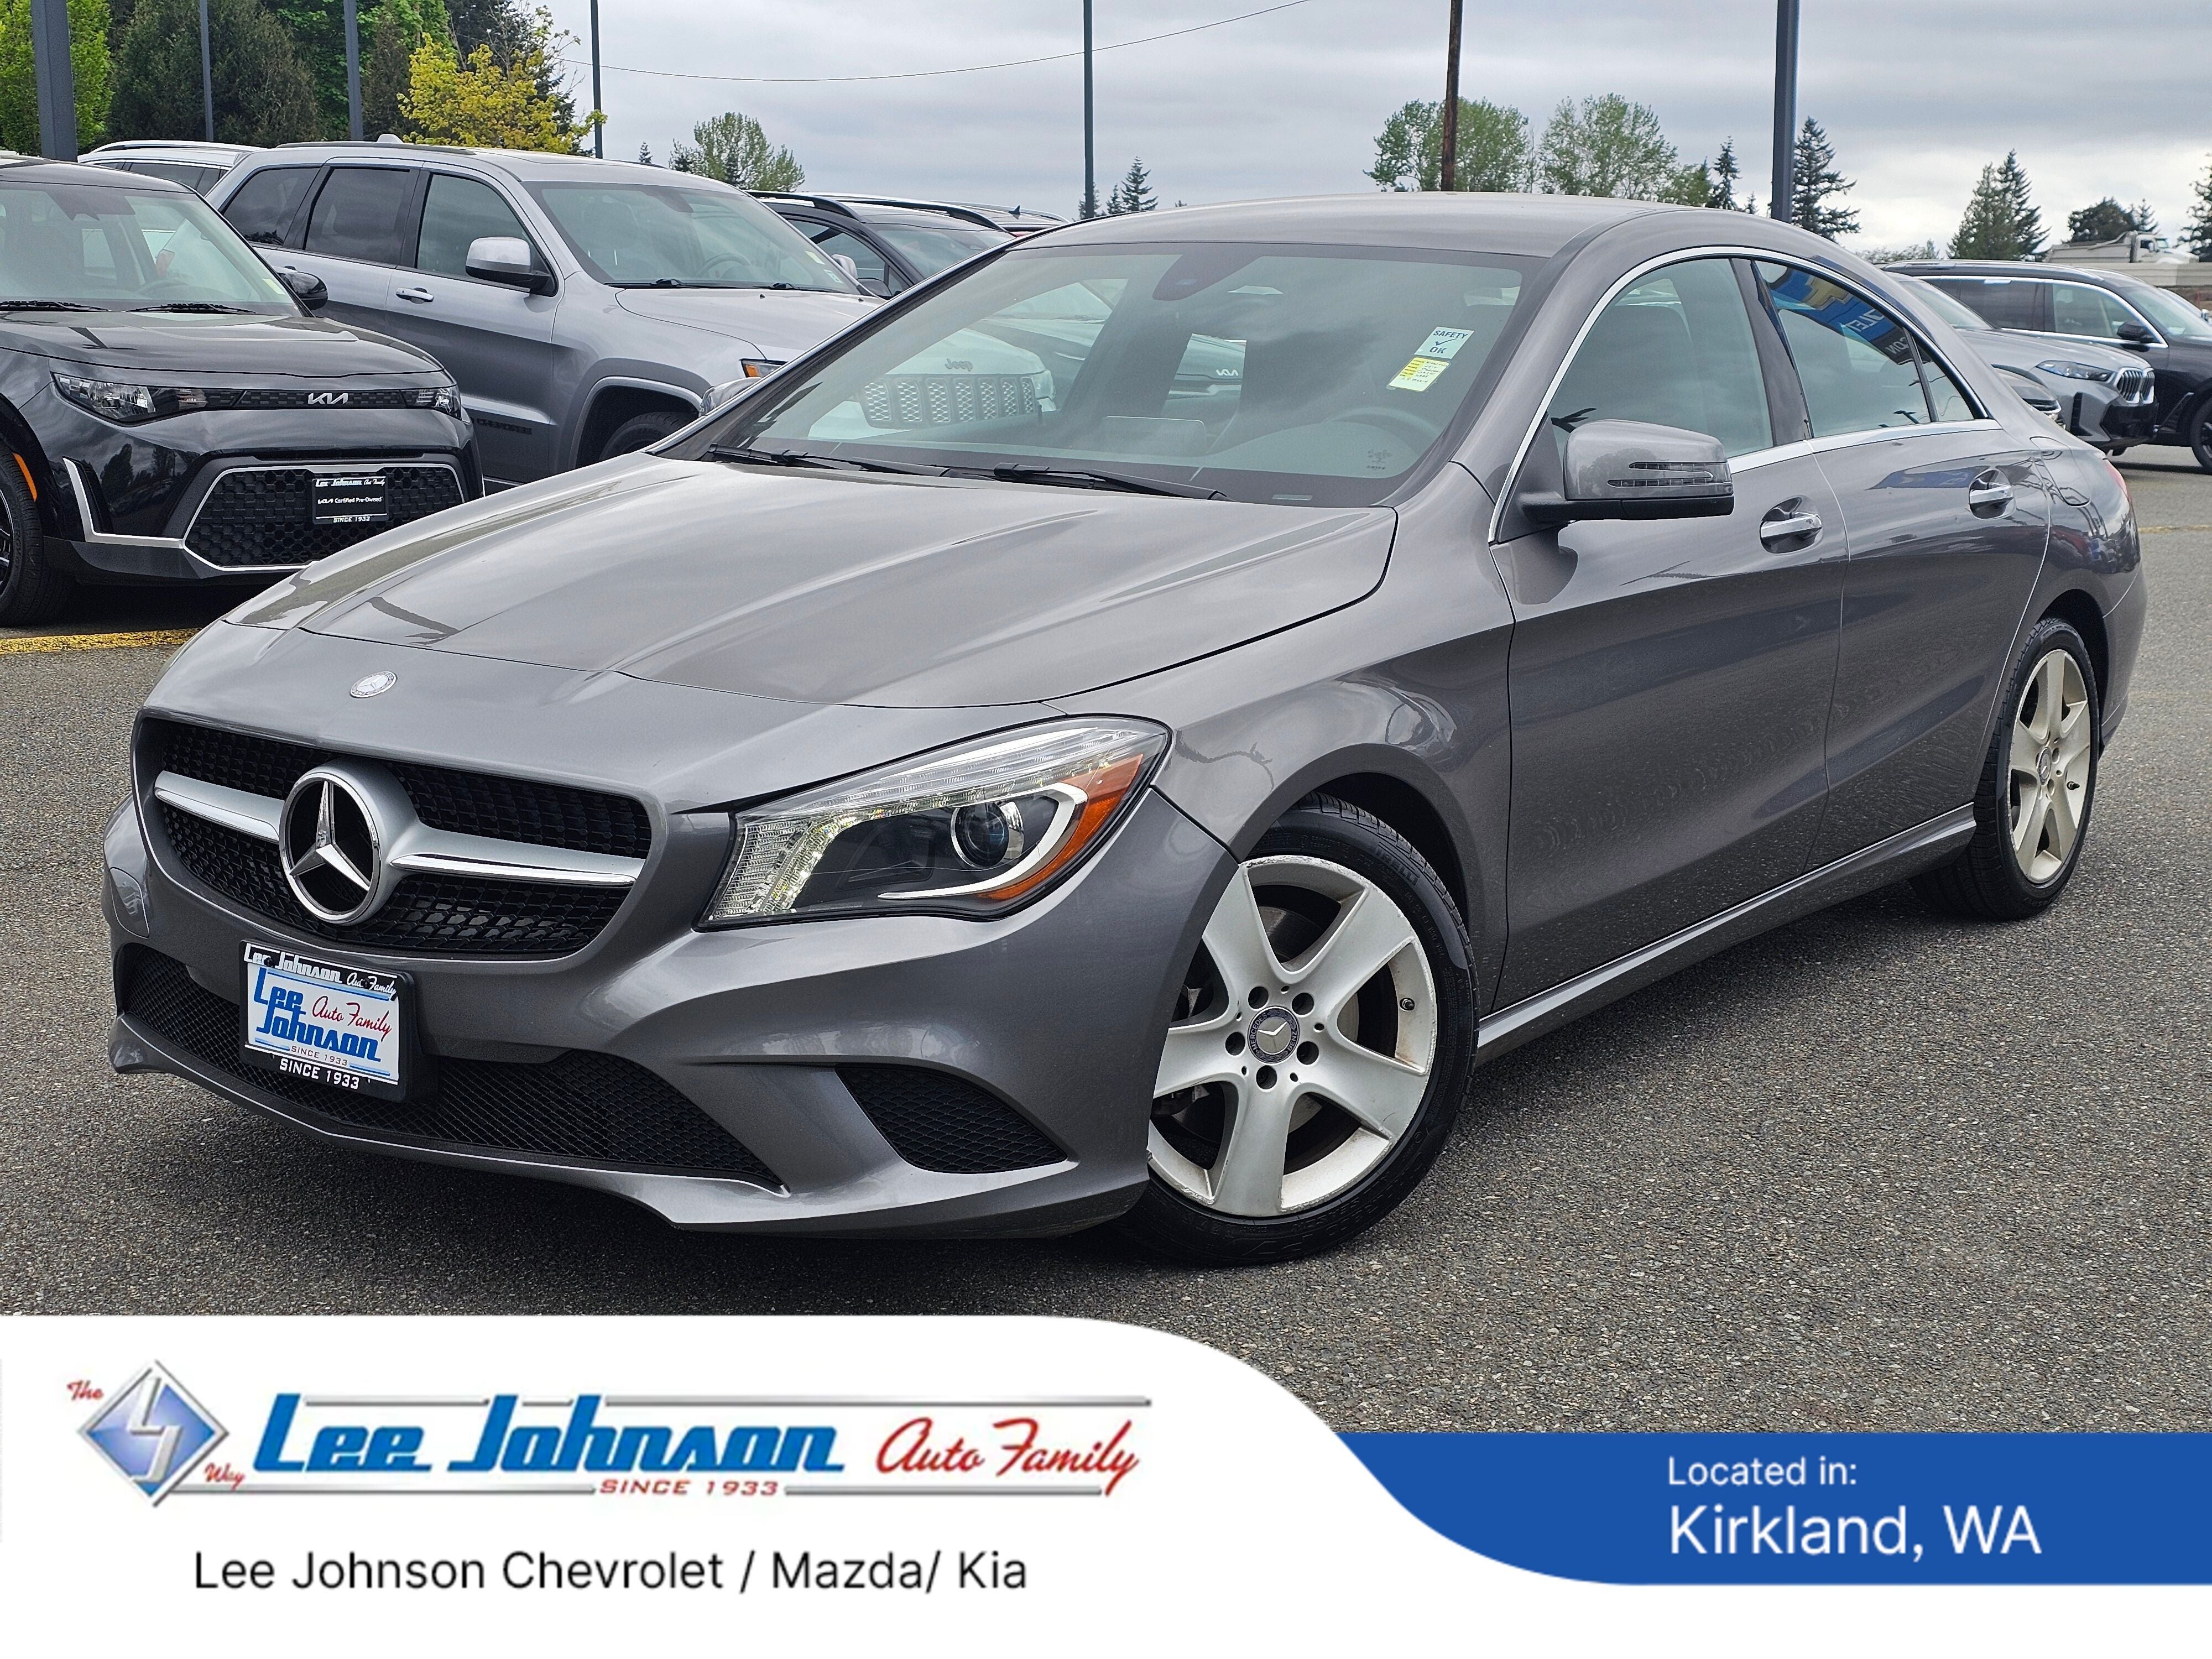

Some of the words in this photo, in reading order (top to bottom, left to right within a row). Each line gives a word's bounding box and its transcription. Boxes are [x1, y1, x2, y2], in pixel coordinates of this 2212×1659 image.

[1433, 330, 1469, 339] SAFETY
[945, 358, 973, 372] Jeep
[254, 968, 306, 1014] Lee
[275, 951, 343, 984] Johnson
[367, 975, 397, 999] Family
[256, 1003, 382, 1062] Johnson
[312, 995, 345, 1021] Auto
[346, 1002, 392, 1042] Family
[1250, 1012, 1267, 1051] MERCEDES
[290, 1045, 320, 1059] SINCE
[325, 1054, 348, 1066] 1933
[1287, 1030, 1297, 1051] BENZ
[279, 1058, 321, 1079] SINCE
[326, 1070, 359, 1090] 1933
